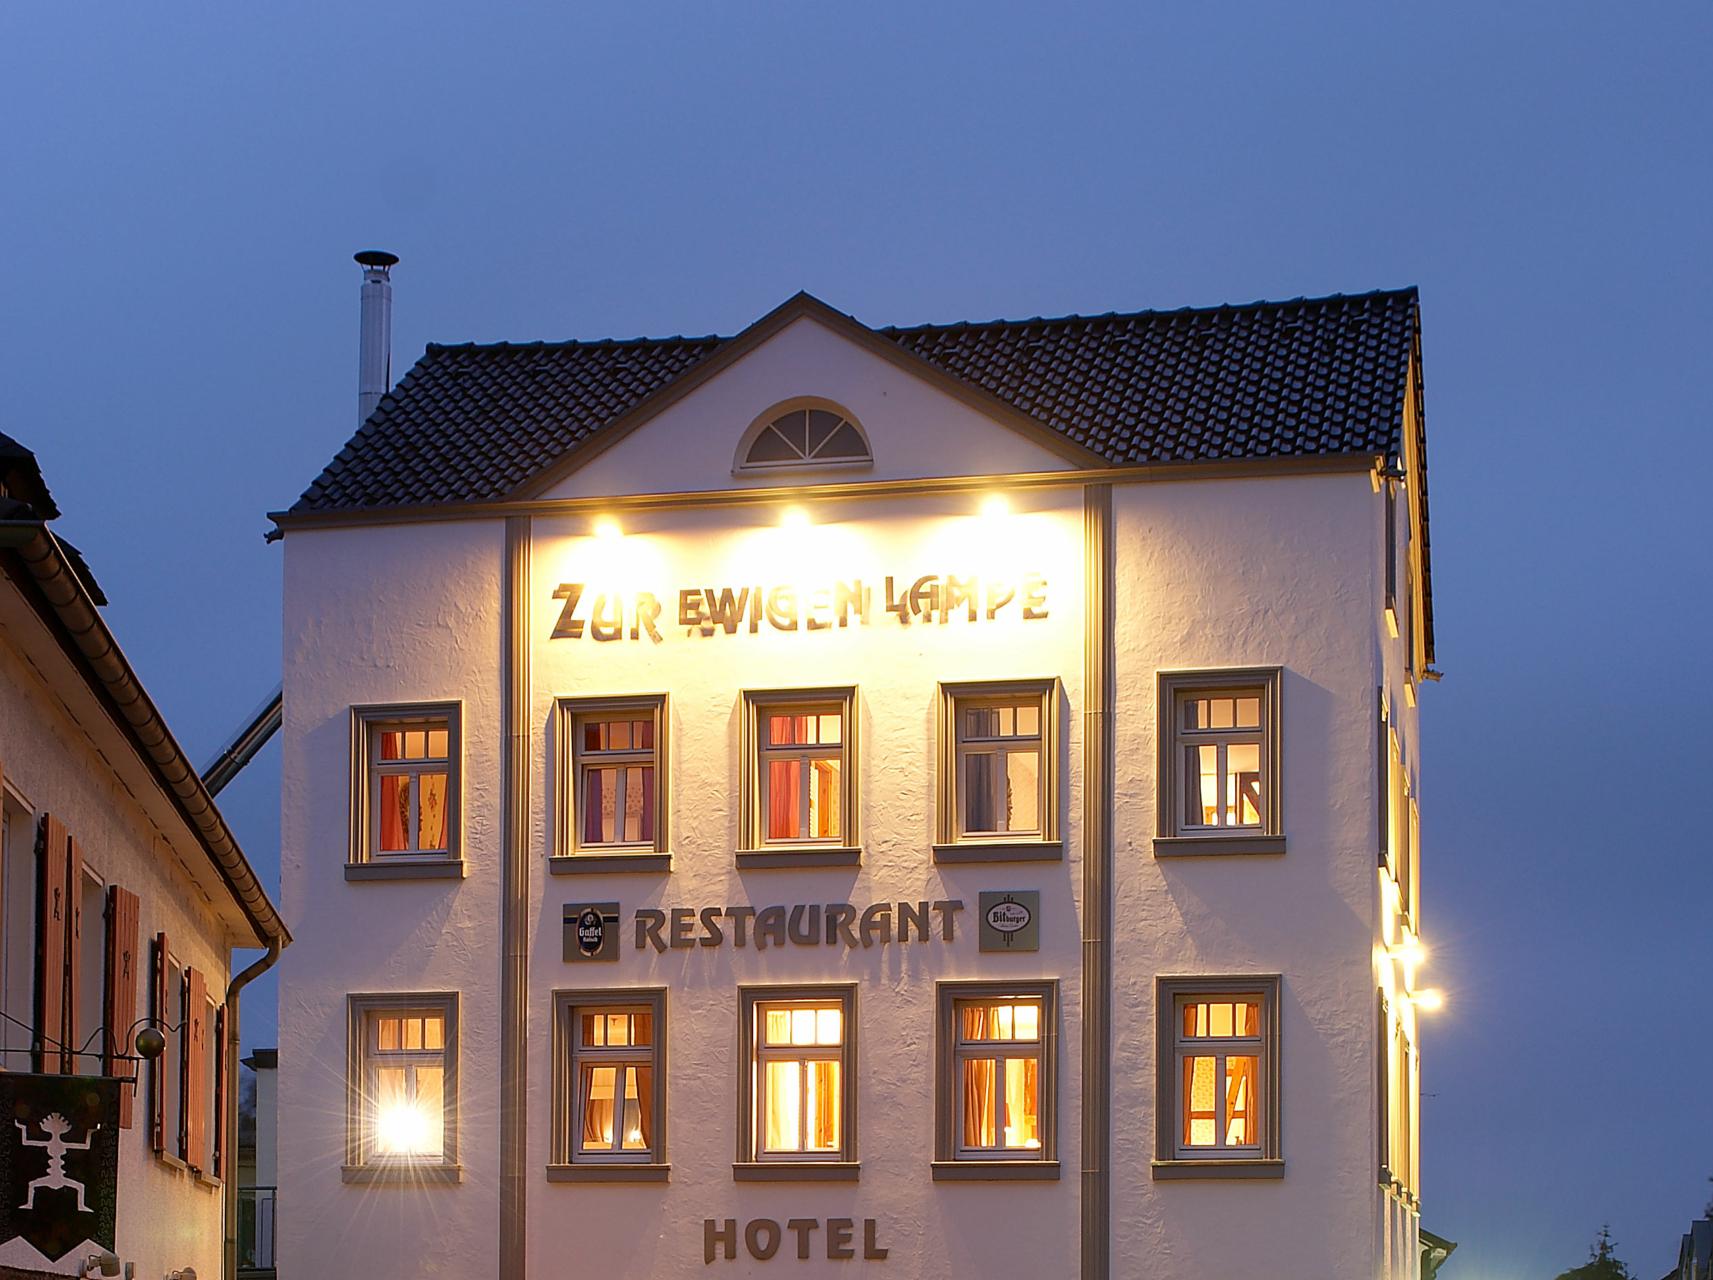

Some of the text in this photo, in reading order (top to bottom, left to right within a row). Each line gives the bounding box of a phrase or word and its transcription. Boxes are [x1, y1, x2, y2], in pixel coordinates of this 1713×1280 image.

[550, 574, 1048, 643] ZUR EWIGEN LAMPE
[579, 926, 602, 937] Gaffel
[634, 901, 964, 953] RESTAURANT
[704, 1218, 889, 1264] HOTEL
